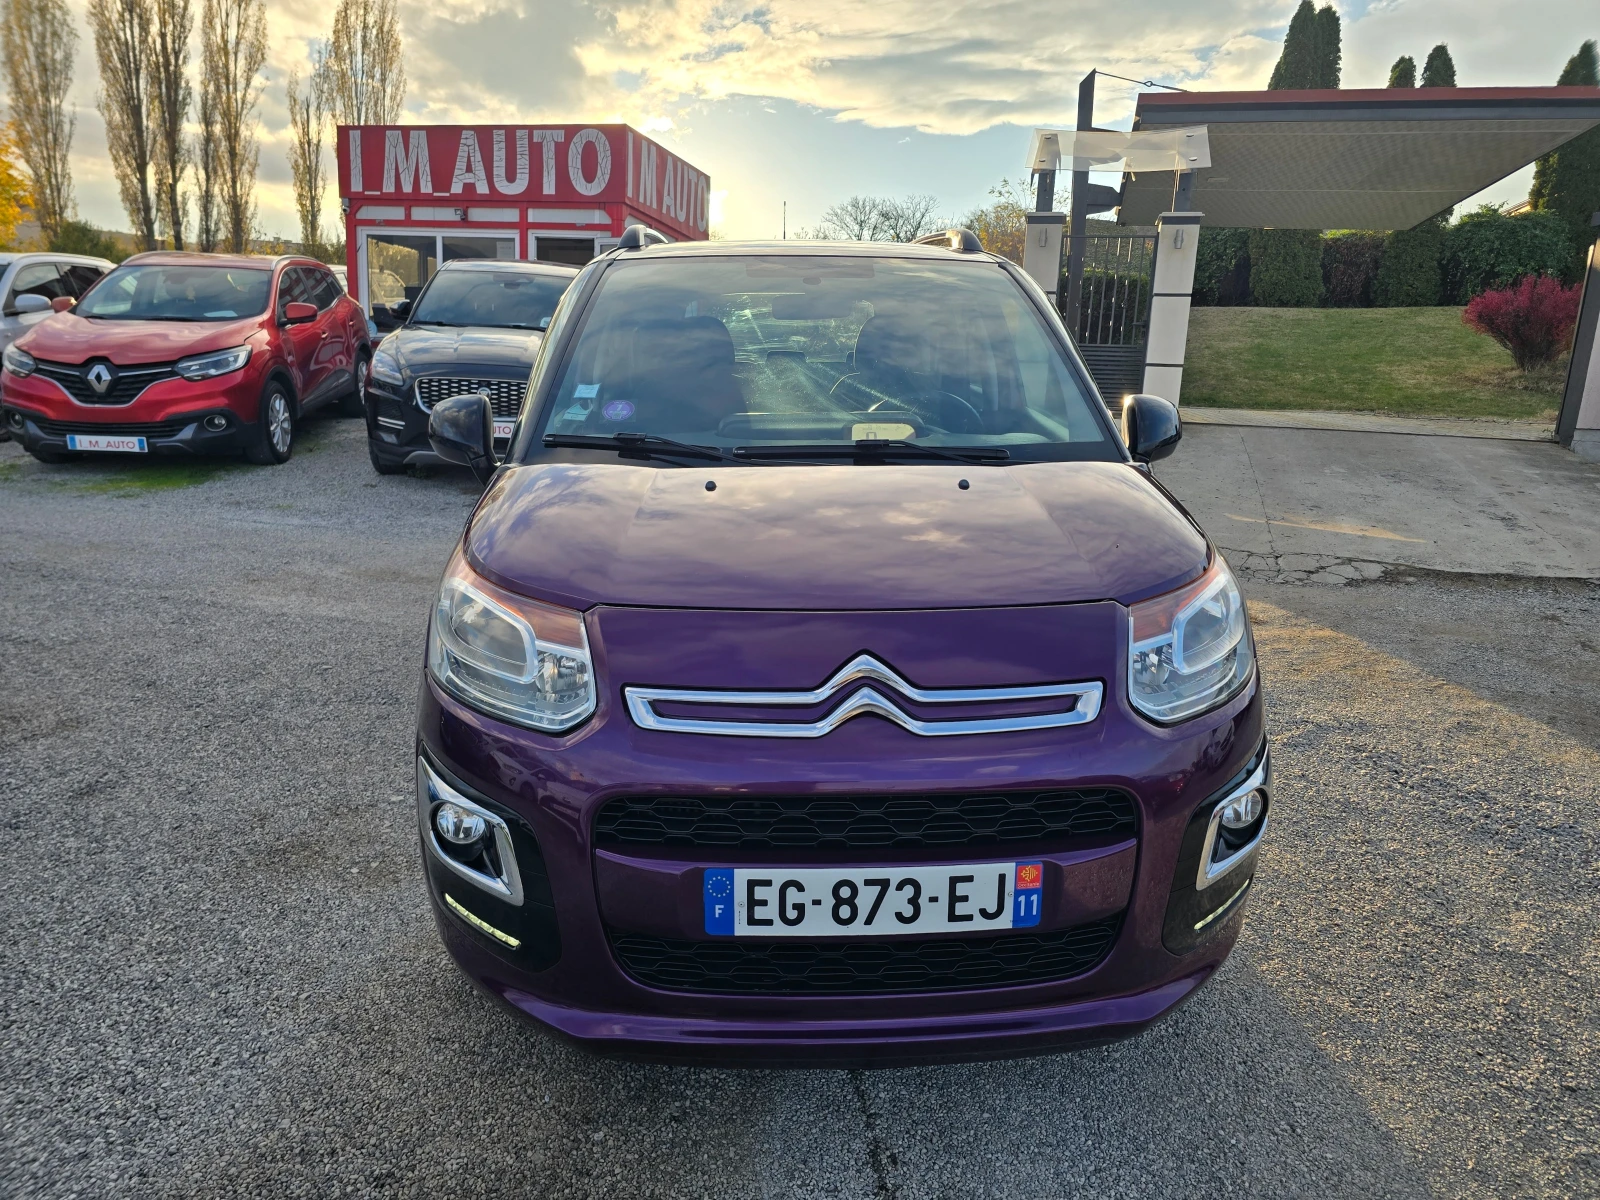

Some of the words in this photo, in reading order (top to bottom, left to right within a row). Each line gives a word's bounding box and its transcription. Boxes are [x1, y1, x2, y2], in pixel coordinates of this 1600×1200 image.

[639, 139, 657, 209] M
[662, 155, 708, 232] AUTO
[715, 904, 725, 918] F
[746, 873, 1006, 927] EG-873-EJ
[1018, 893, 1038, 917] 11
